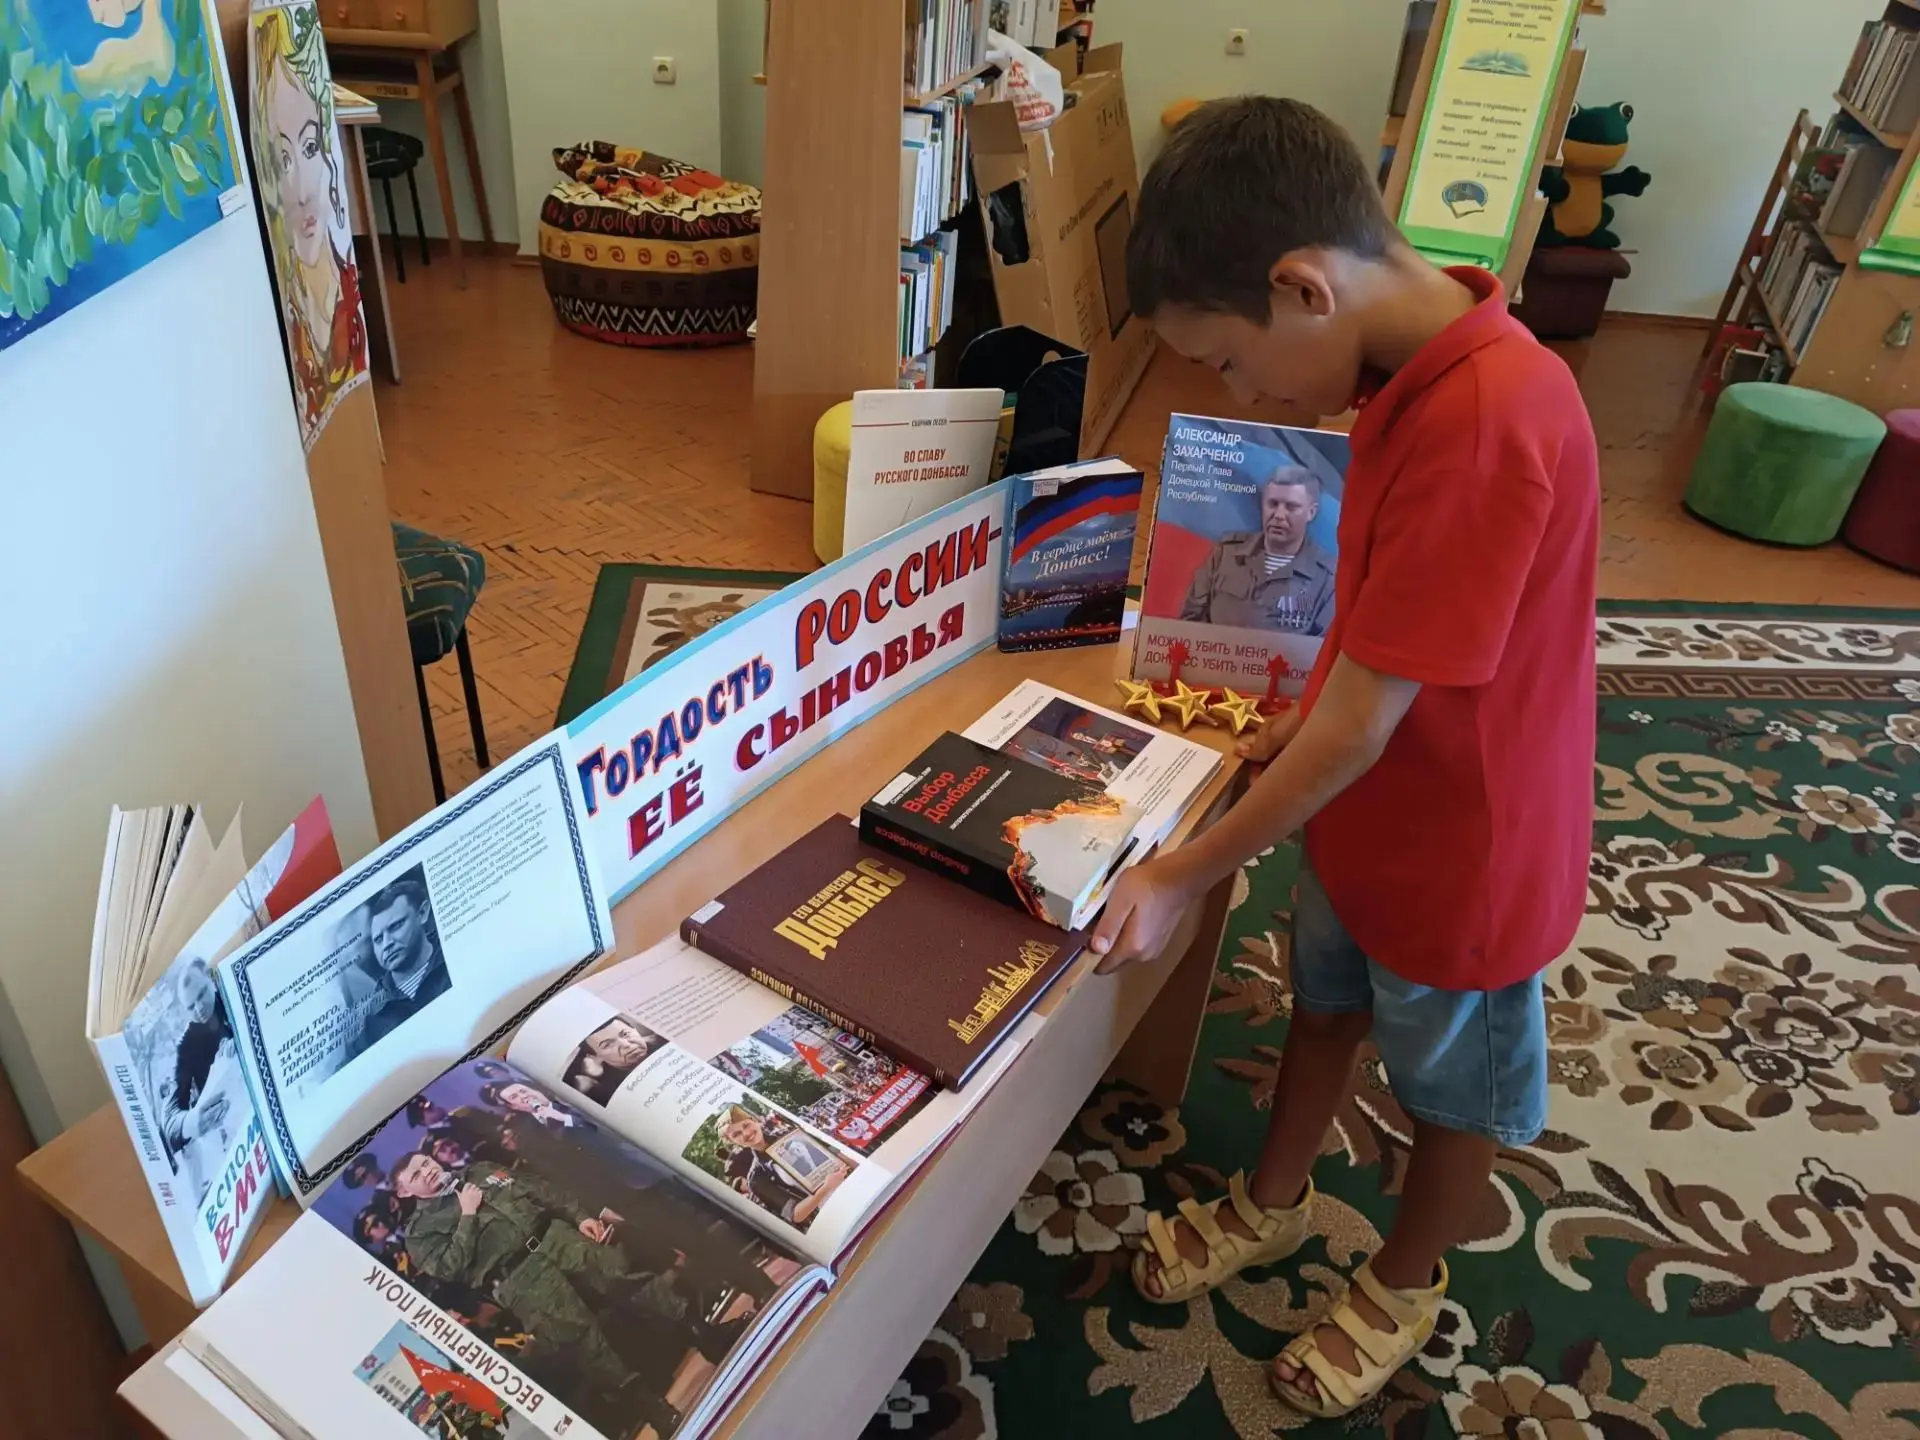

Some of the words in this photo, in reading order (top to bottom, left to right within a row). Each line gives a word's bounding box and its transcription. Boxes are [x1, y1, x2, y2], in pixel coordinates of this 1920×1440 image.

[1172, 444, 1244, 464] ЗАХАРЧЕНКО
[1174, 427, 1242, 447] АЛЕКСАНДР
[904, 450, 915, 463] ВО
[917, 448, 946, 462] СЛАВУ
[1171, 460, 1205, 474] Первый
[1207, 464, 1232, 477] Глава
[874, 469, 918, 485] РУССКОГО
[920, 465, 969, 481] ДОНБАССА!
[1168, 473, 1211, 489] Донецкой
[1213, 481, 1257, 494] Народной
[1031, 550, 1040, 564] В
[1042, 542, 1083, 562] сердце
[1085, 531, 1118, 547] моём
[1036, 546, 1110, 580] Донбасс!
[1196, 640, 1230, 654] УБИТЬ
[1203, 658, 1238, 673] УБИТЬ
[628, 759, 704, 860] ЕЁ
[733, 602, 965, 772] СЫНОВЬЯ
[902, 772, 955, 812] Выбор
[923, 765, 991, 823] Донбасса
[772, 857, 906, 960] ДОНБАСС
[791, 905, 814, 921] ЕГО
[807, 869, 859, 912] ВЕЛИЧЕСТВО
[265, 975, 307, 1009] АЛЕКСАНДР
[307, 933, 362, 976] ВЛАДИМИРОВИЧ
[293, 958, 338, 995] ЗАХАРЧЕНКО
[750, 966, 794, 1002] ДОНБАСС
[280, 1052, 292, 1067] ЗА
[294, 1035, 314, 1053] ЧТО
[316, 1021, 333, 1041] МЫ
[285, 1053, 324, 1087] НАШЕЙ
[362, 1264, 417, 1313] ПОЛК
[410, 1303, 545, 1414] БЕССМЕРТНЫЙ
